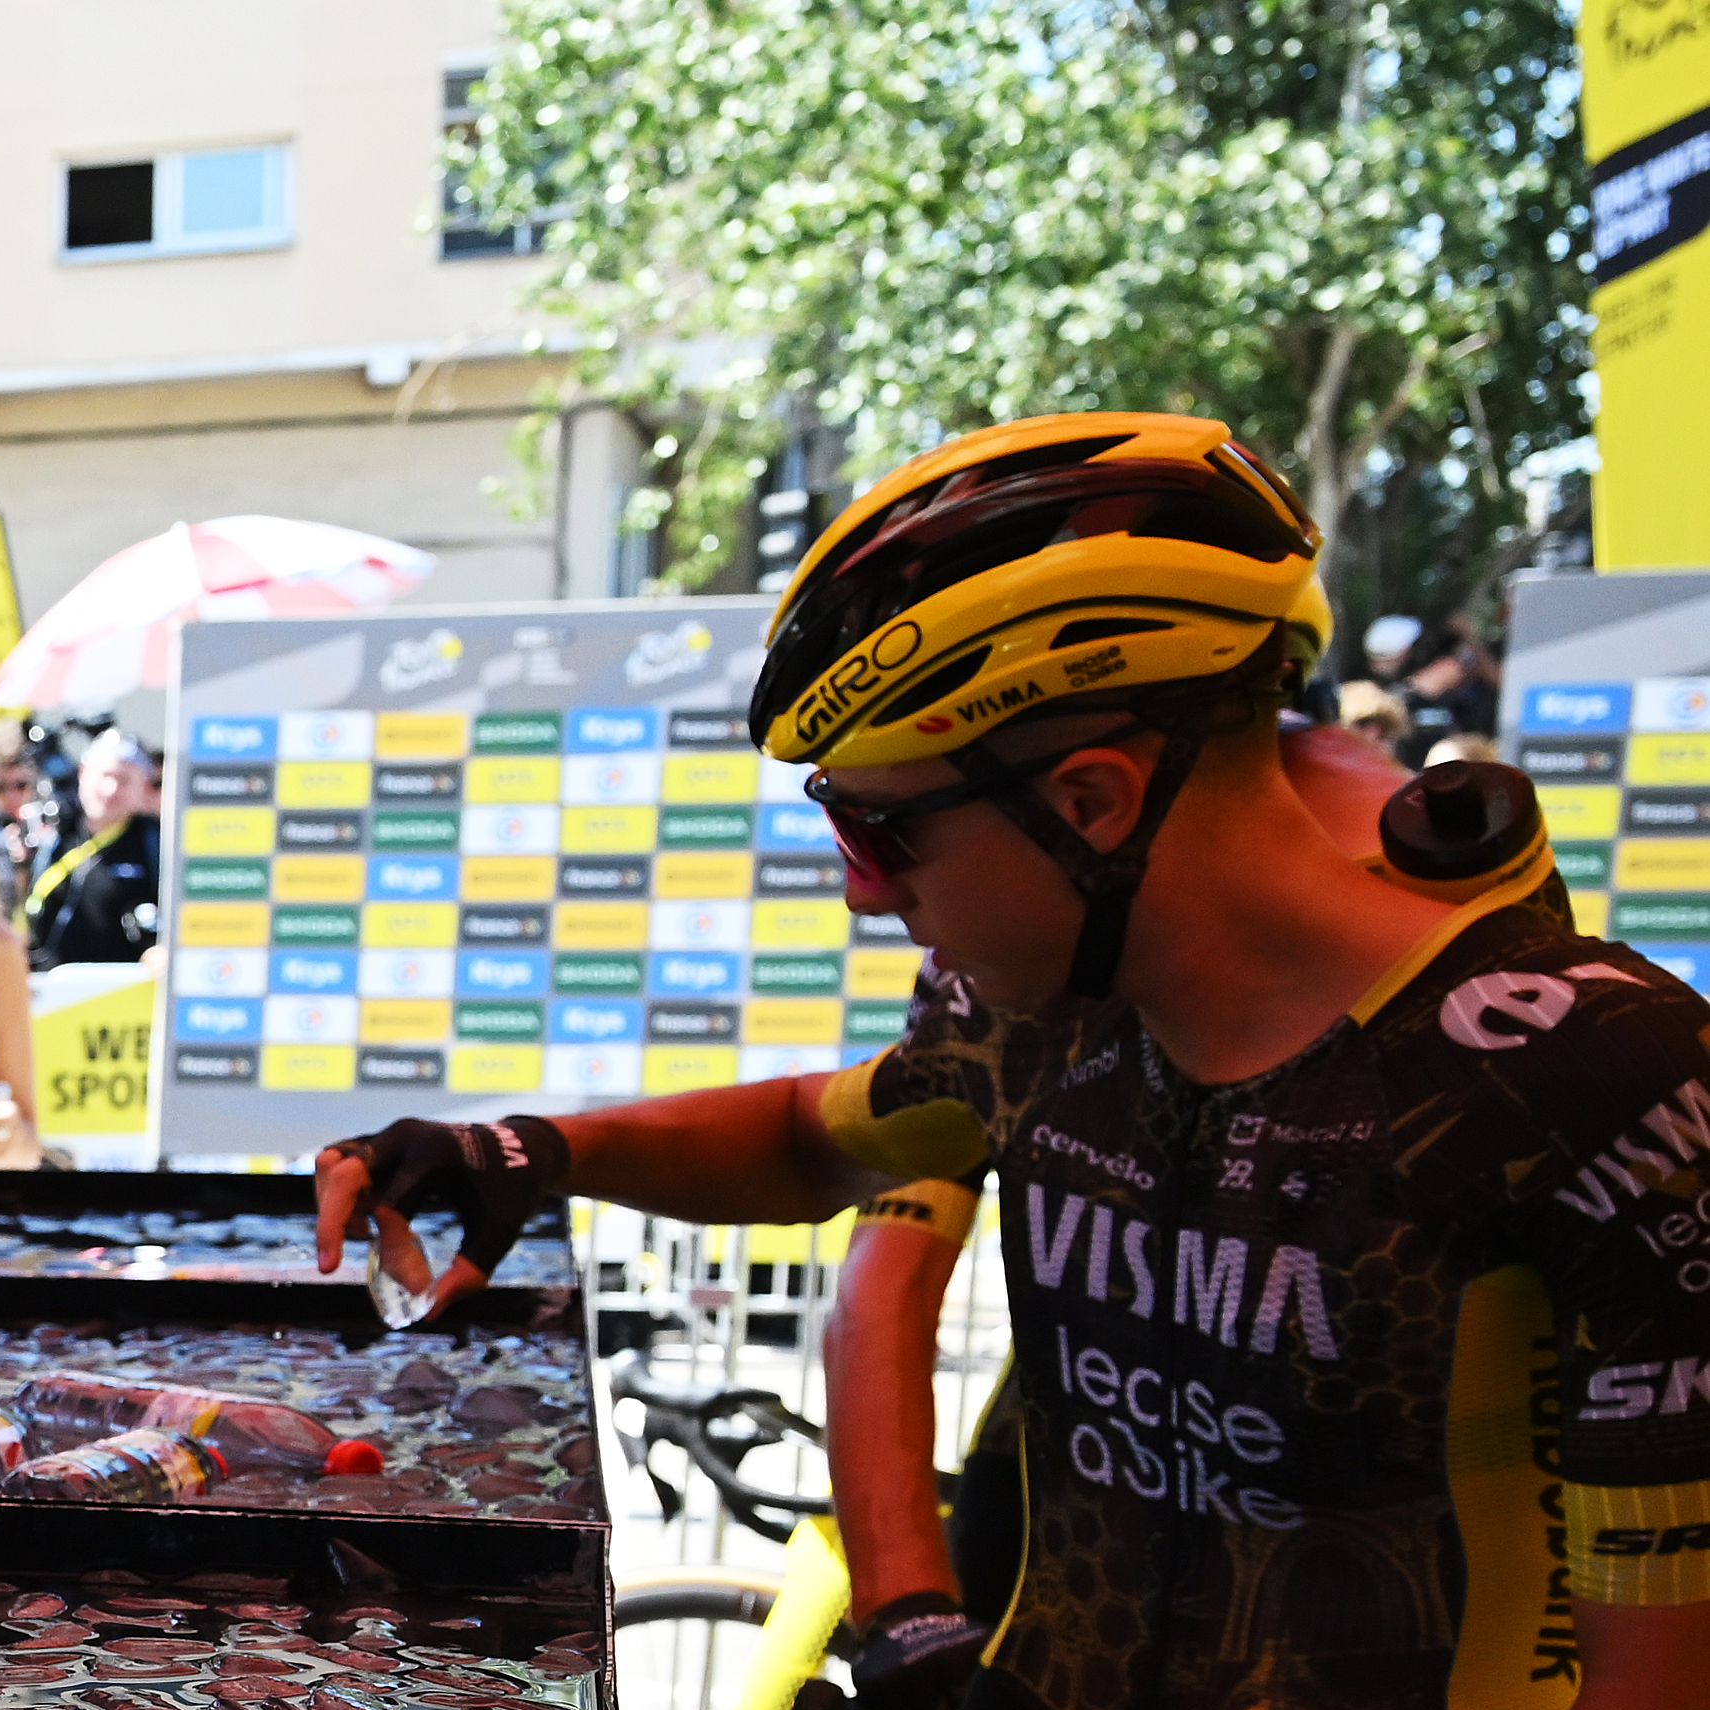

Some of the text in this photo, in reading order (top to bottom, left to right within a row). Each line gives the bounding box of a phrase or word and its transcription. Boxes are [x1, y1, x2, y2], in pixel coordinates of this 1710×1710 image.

[796, 620, 923, 743] GIRO
[956, 680, 1044, 723] VISMA
[1026, 1183, 1338, 1361] VISMA
[1056, 1324, 1286, 1464] lease
